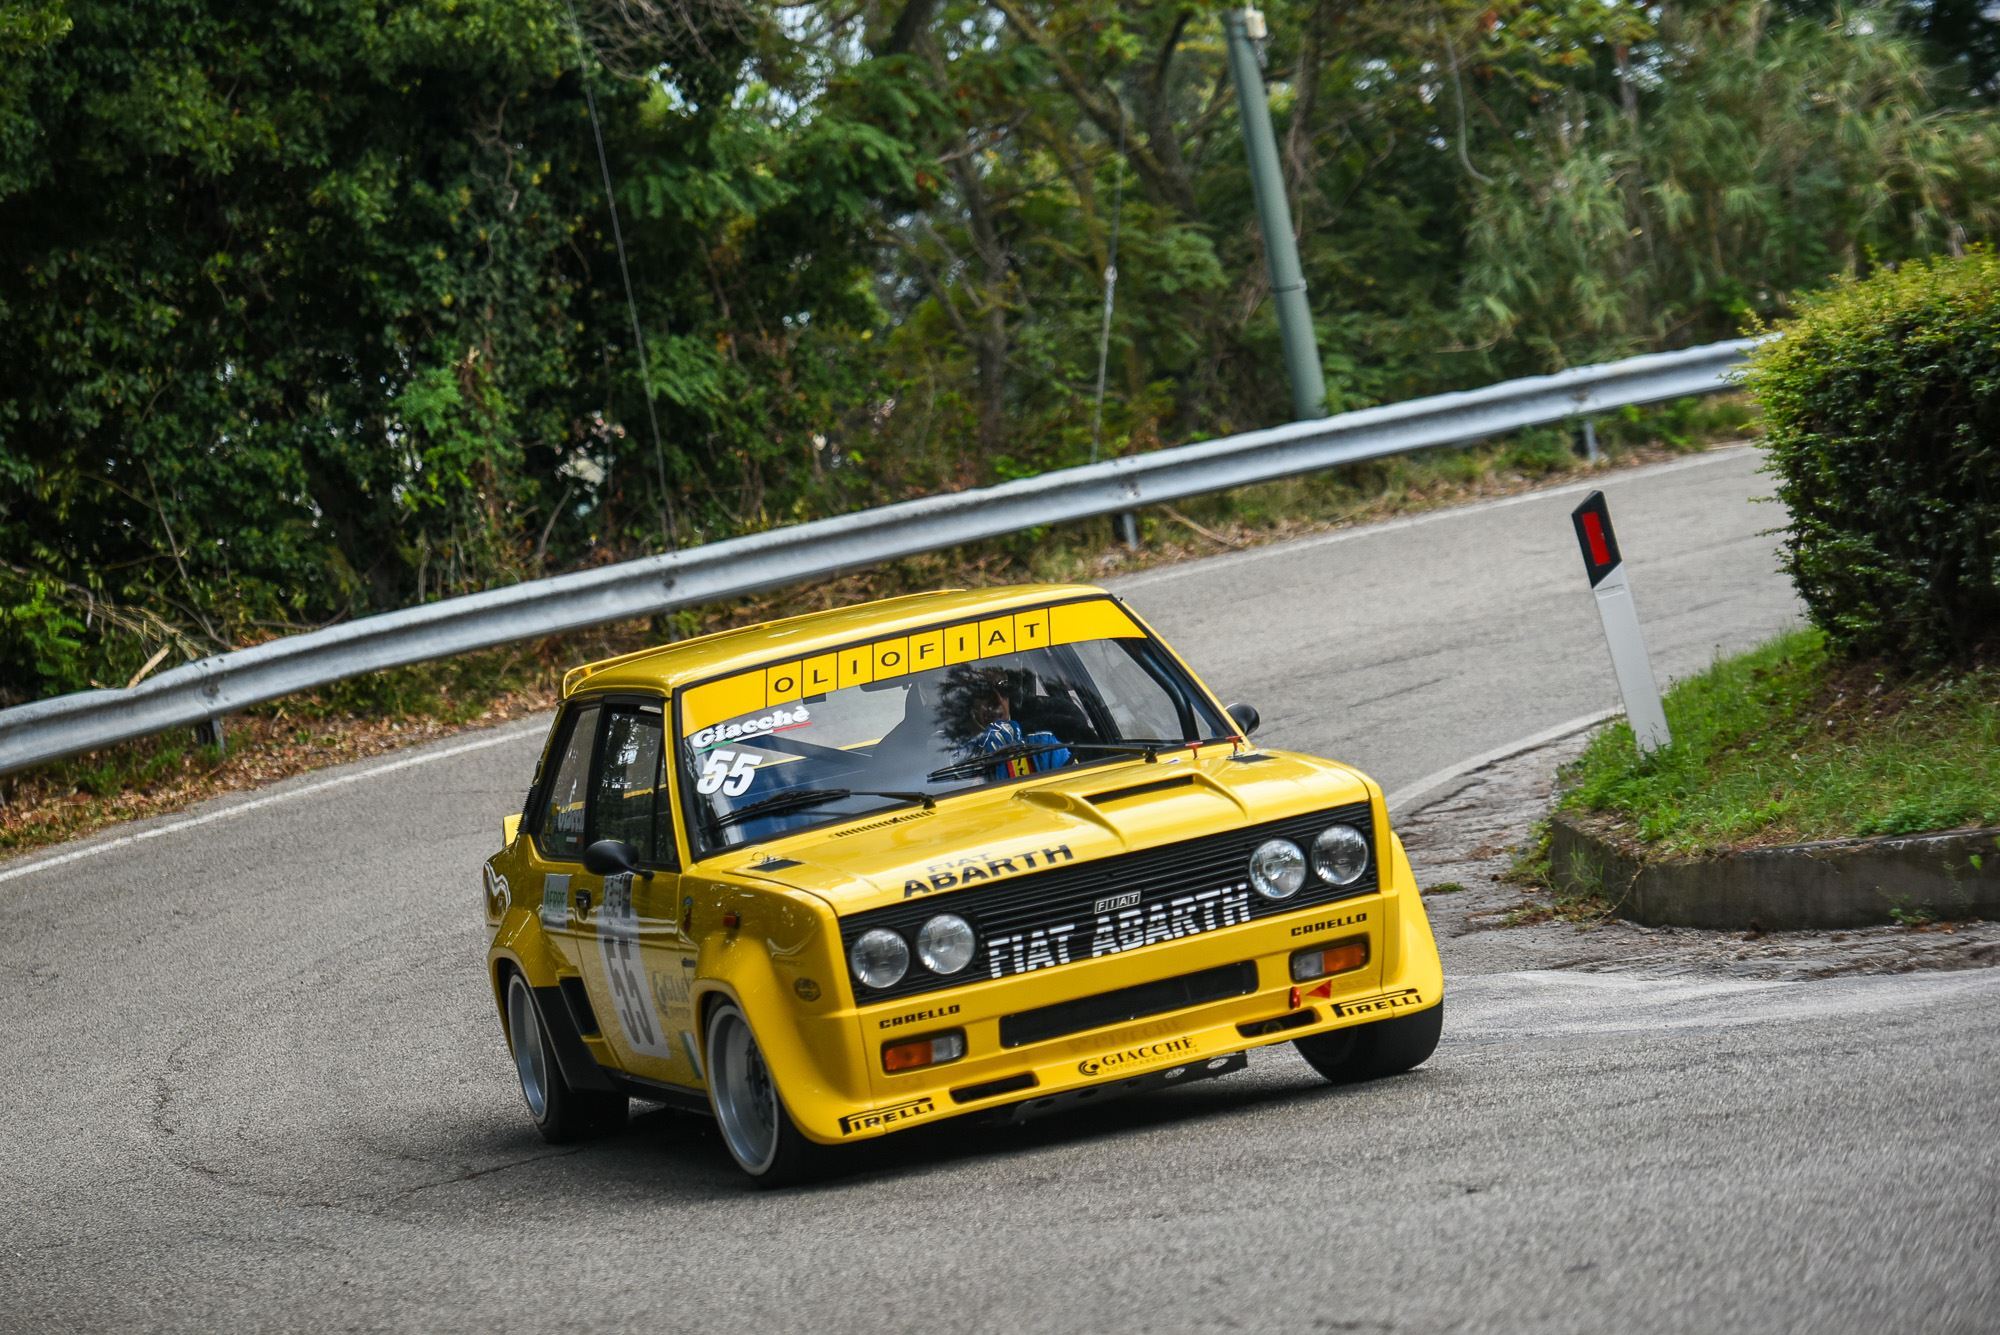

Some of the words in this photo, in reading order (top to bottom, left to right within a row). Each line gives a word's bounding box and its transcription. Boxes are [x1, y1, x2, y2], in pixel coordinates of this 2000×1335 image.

[693, 705, 810, 748] Giacchè
[697, 750, 763, 797] 55
[903, 844, 1074, 899] ABARTH
[928, 852, 990, 872] FIAT
[1096, 892, 1140, 912] FIAT
[988, 924, 1075, 979] FIAT
[1092, 883, 1250, 958] ABARTH
[1291, 912, 1367, 936] CARELLO
[603, 936, 656, 1046] 55
[1331, 987, 1422, 1018] PIRELLI
[879, 1004, 960, 1029] CARELLO
[1101, 1036, 1196, 1066] GIACCHÈ
[838, 1097, 935, 1136] PIRELLI
